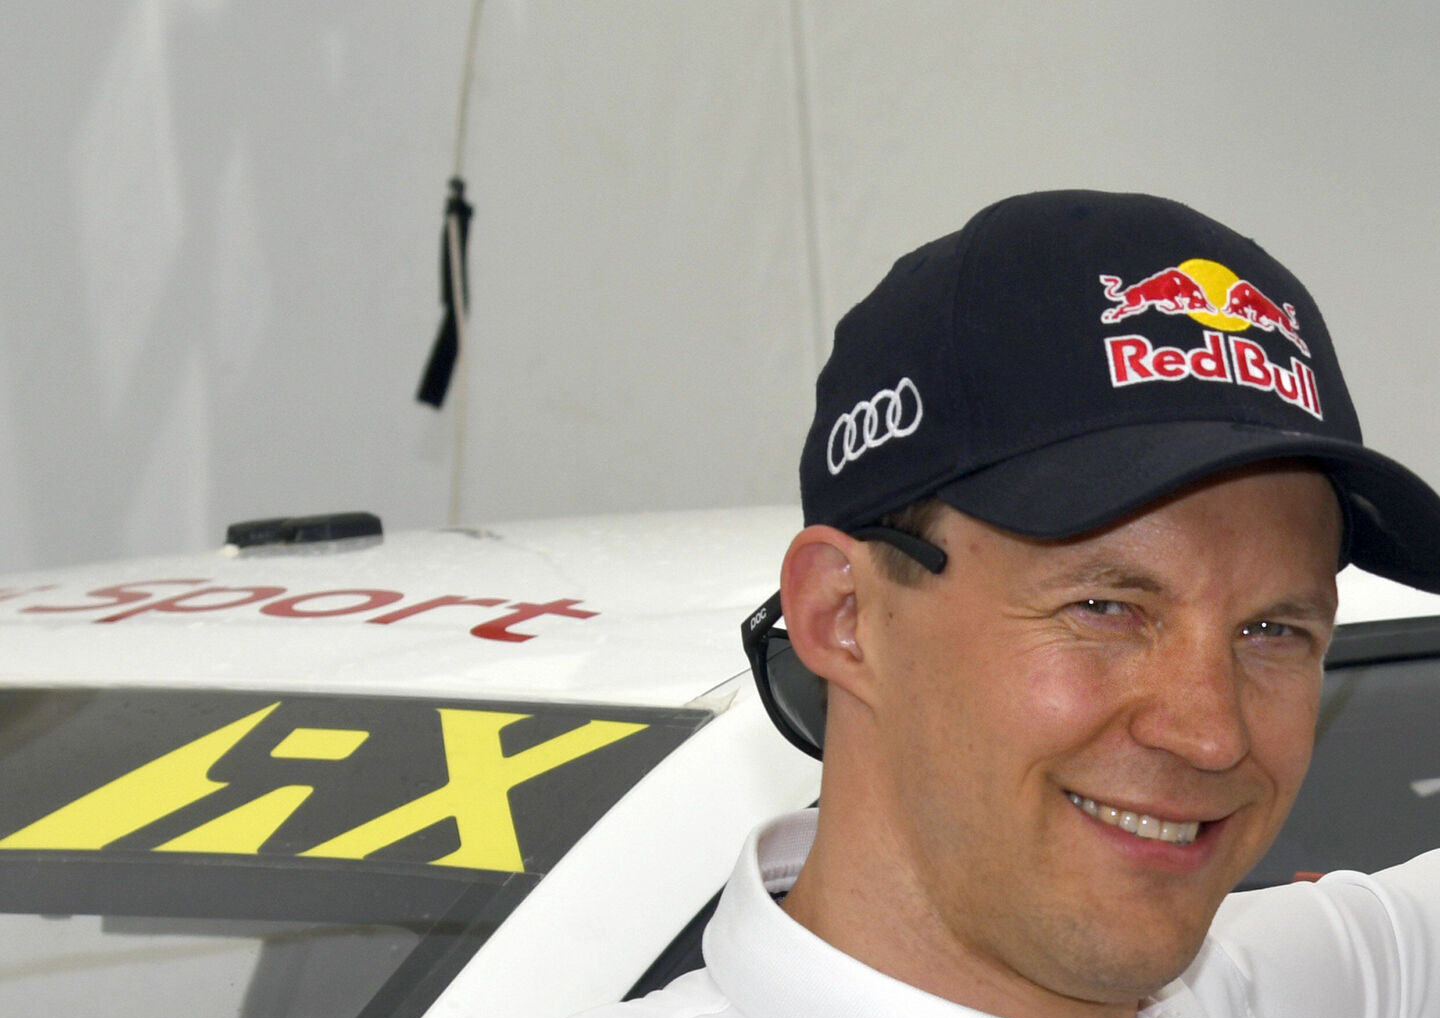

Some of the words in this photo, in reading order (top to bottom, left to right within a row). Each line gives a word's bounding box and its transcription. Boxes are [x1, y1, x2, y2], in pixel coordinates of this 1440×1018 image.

[1106, 332, 1231, 386] Red
[1230, 337, 1322, 419] Bull
[18, 577, 602, 642] Sport
